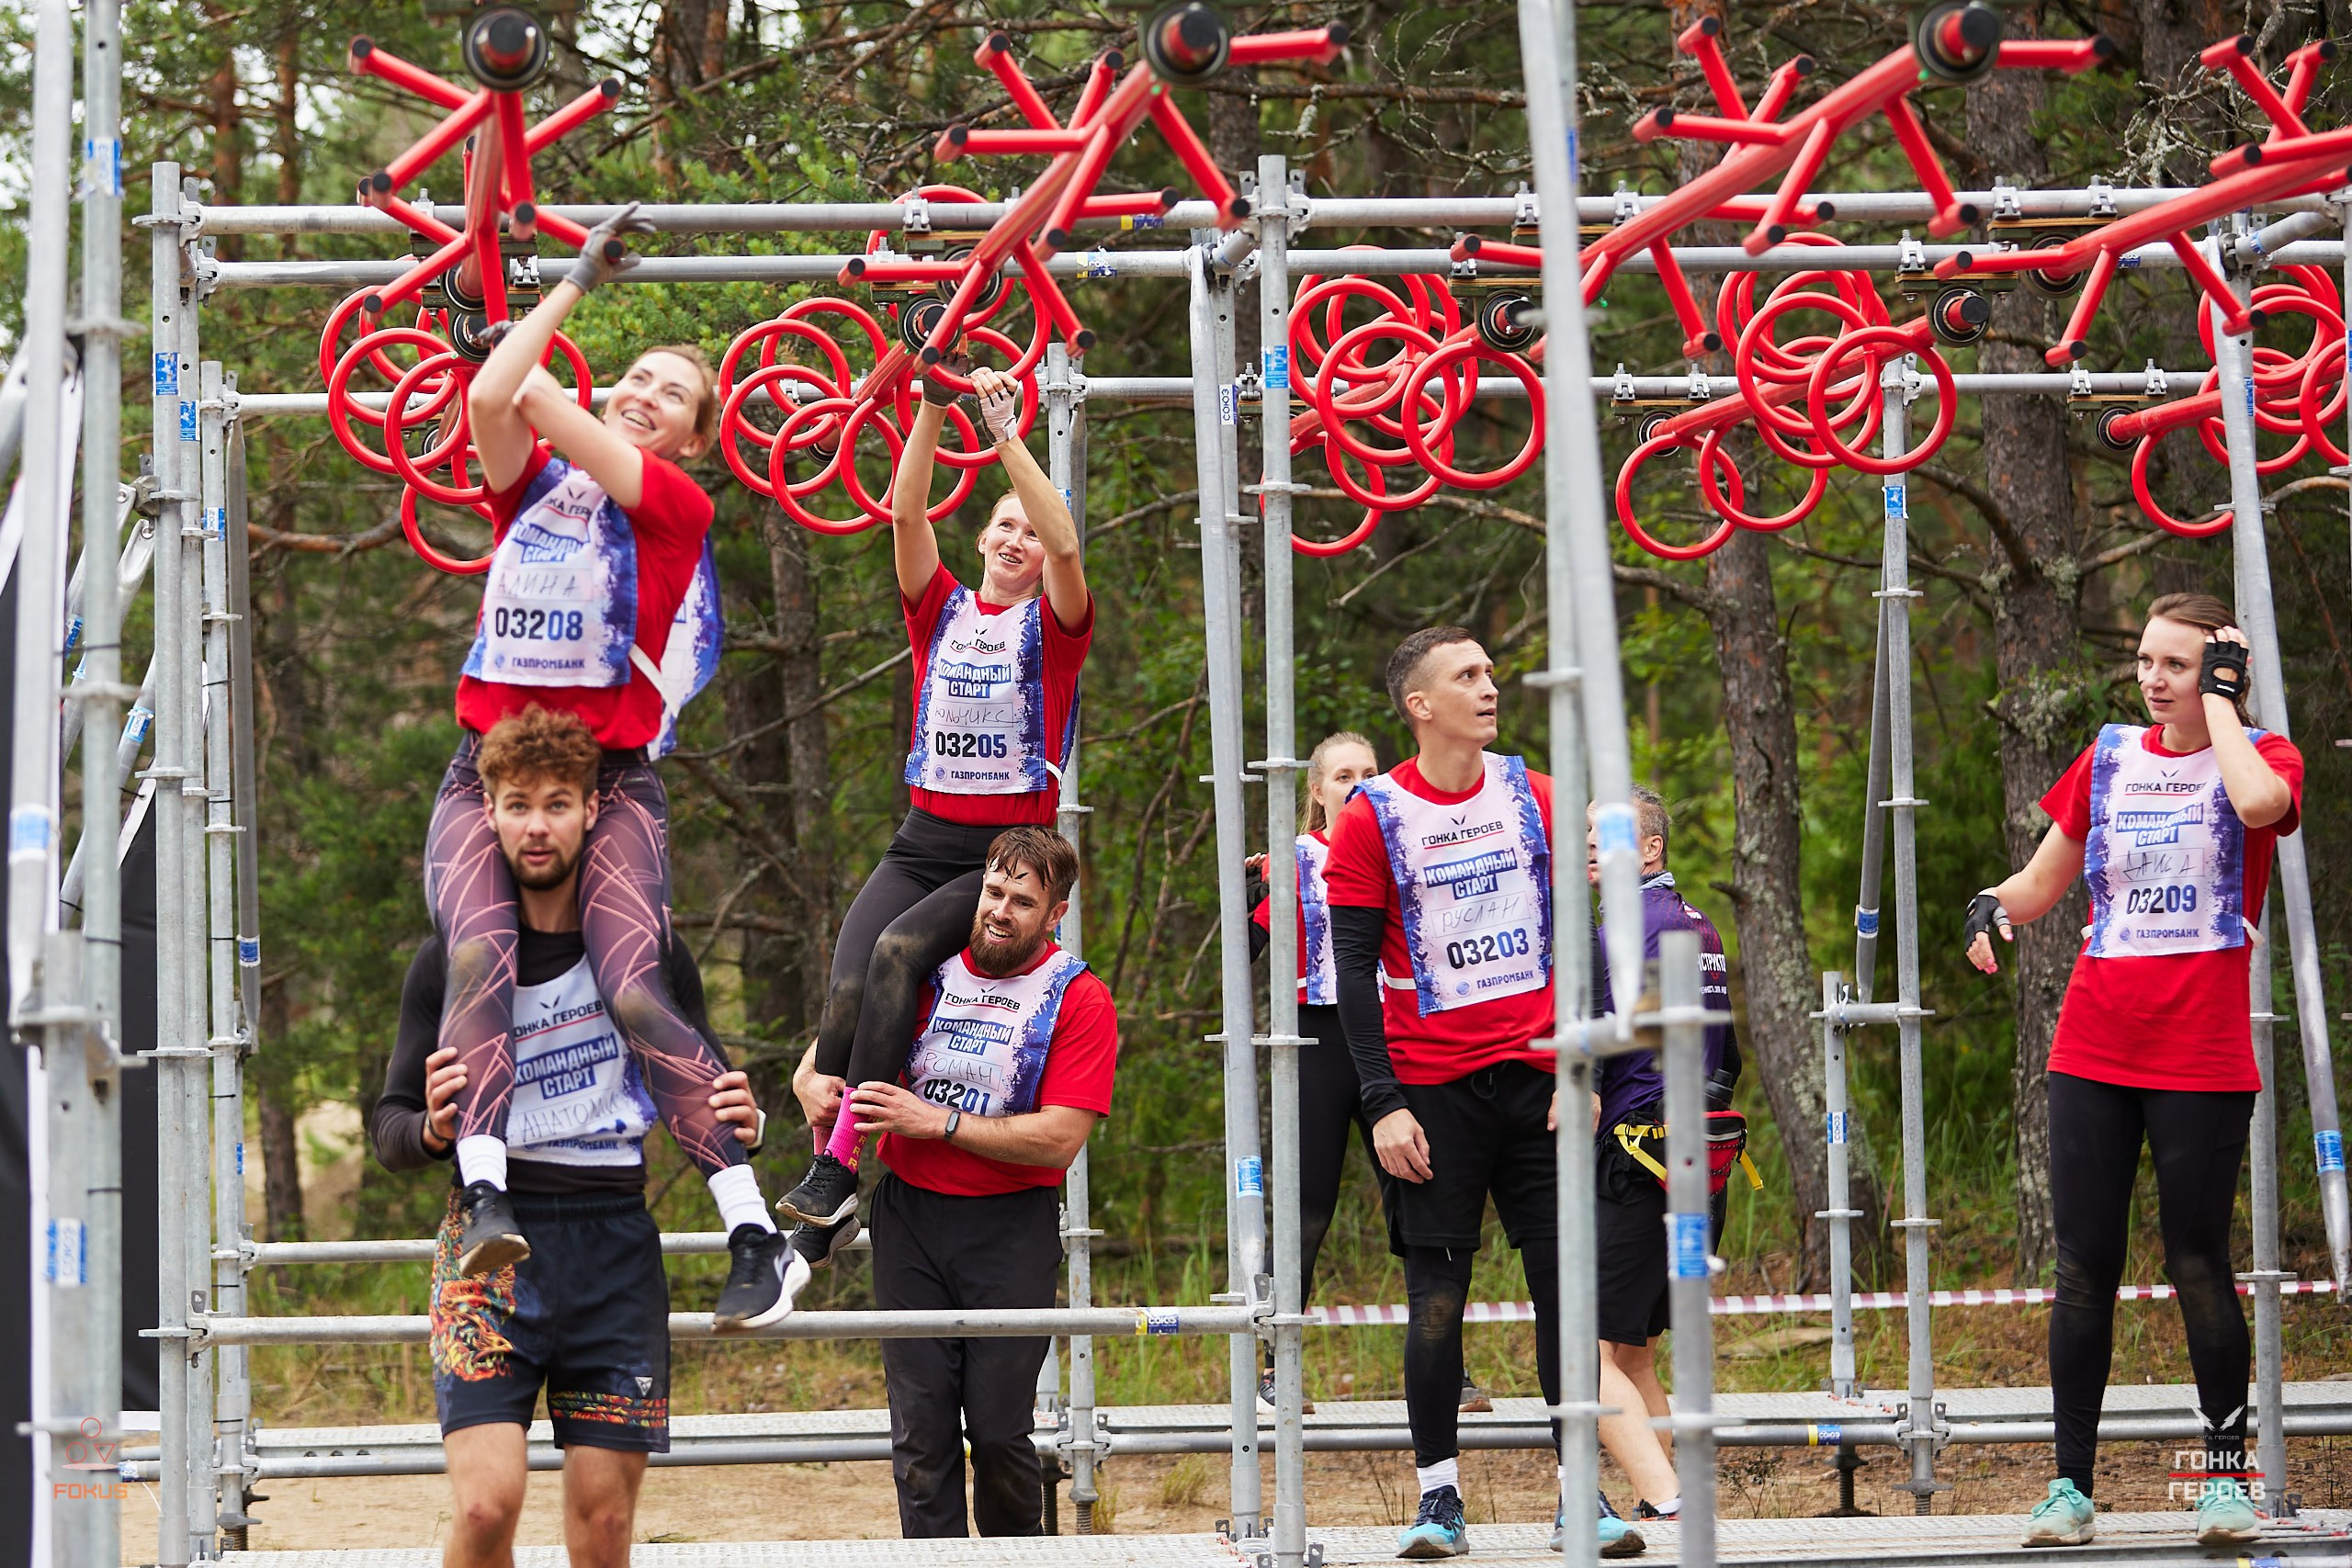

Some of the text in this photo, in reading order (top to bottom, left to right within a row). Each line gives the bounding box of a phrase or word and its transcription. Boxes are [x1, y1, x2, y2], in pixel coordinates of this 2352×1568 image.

[1221, 389, 1231, 422] СОЮЗ
[494, 607, 583, 640] 03208
[512, 656, 585, 669] ГАЗПРОМБАНК
[939, 661, 1010, 682] КОМАНДНЫЙ
[950, 681, 989, 697] СТАРТ
[935, 731, 1008, 759] 03205
[951, 770, 1010, 781] ГАЗПРОМБАНК
[2125, 782, 2162, 793] ГОНКА
[2117, 803, 2202, 830] КОМАНДНЫЙ
[1422, 821, 1504, 846] ГОНКА ГЕРОЕВ
[2137, 827, 2177, 845] СТАРТ
[1426, 849, 1517, 885] КОМАНДНЫЙ
[1455, 874, 1497, 898] СТАРТ
[2127, 885, 2197, 914] 03209
[1442, 897, 1520, 932] РУСЛАН
[2136, 928, 2199, 939] ГАЗПРОМБАНК
[1447, 928, 1529, 969] 03203
[1476, 970, 1534, 989] ГАЗПРОМБАНК
[945, 993, 1021, 1010] ГОНКА ГЕРОЕВ
[514, 999, 604, 1037] ОНКА ГЕРОЕВ
[934, 1019, 1013, 1043] КОМАНДНЫЙ
[515, 1033, 616, 1083] КОМАНДНЫЙ
[951, 1036, 986, 1054] СТАРТ
[922, 1053, 992, 1084] РОМАН
[542, 1067, 594, 1097] СТАРТ
[923, 1079, 991, 1116] 03201
